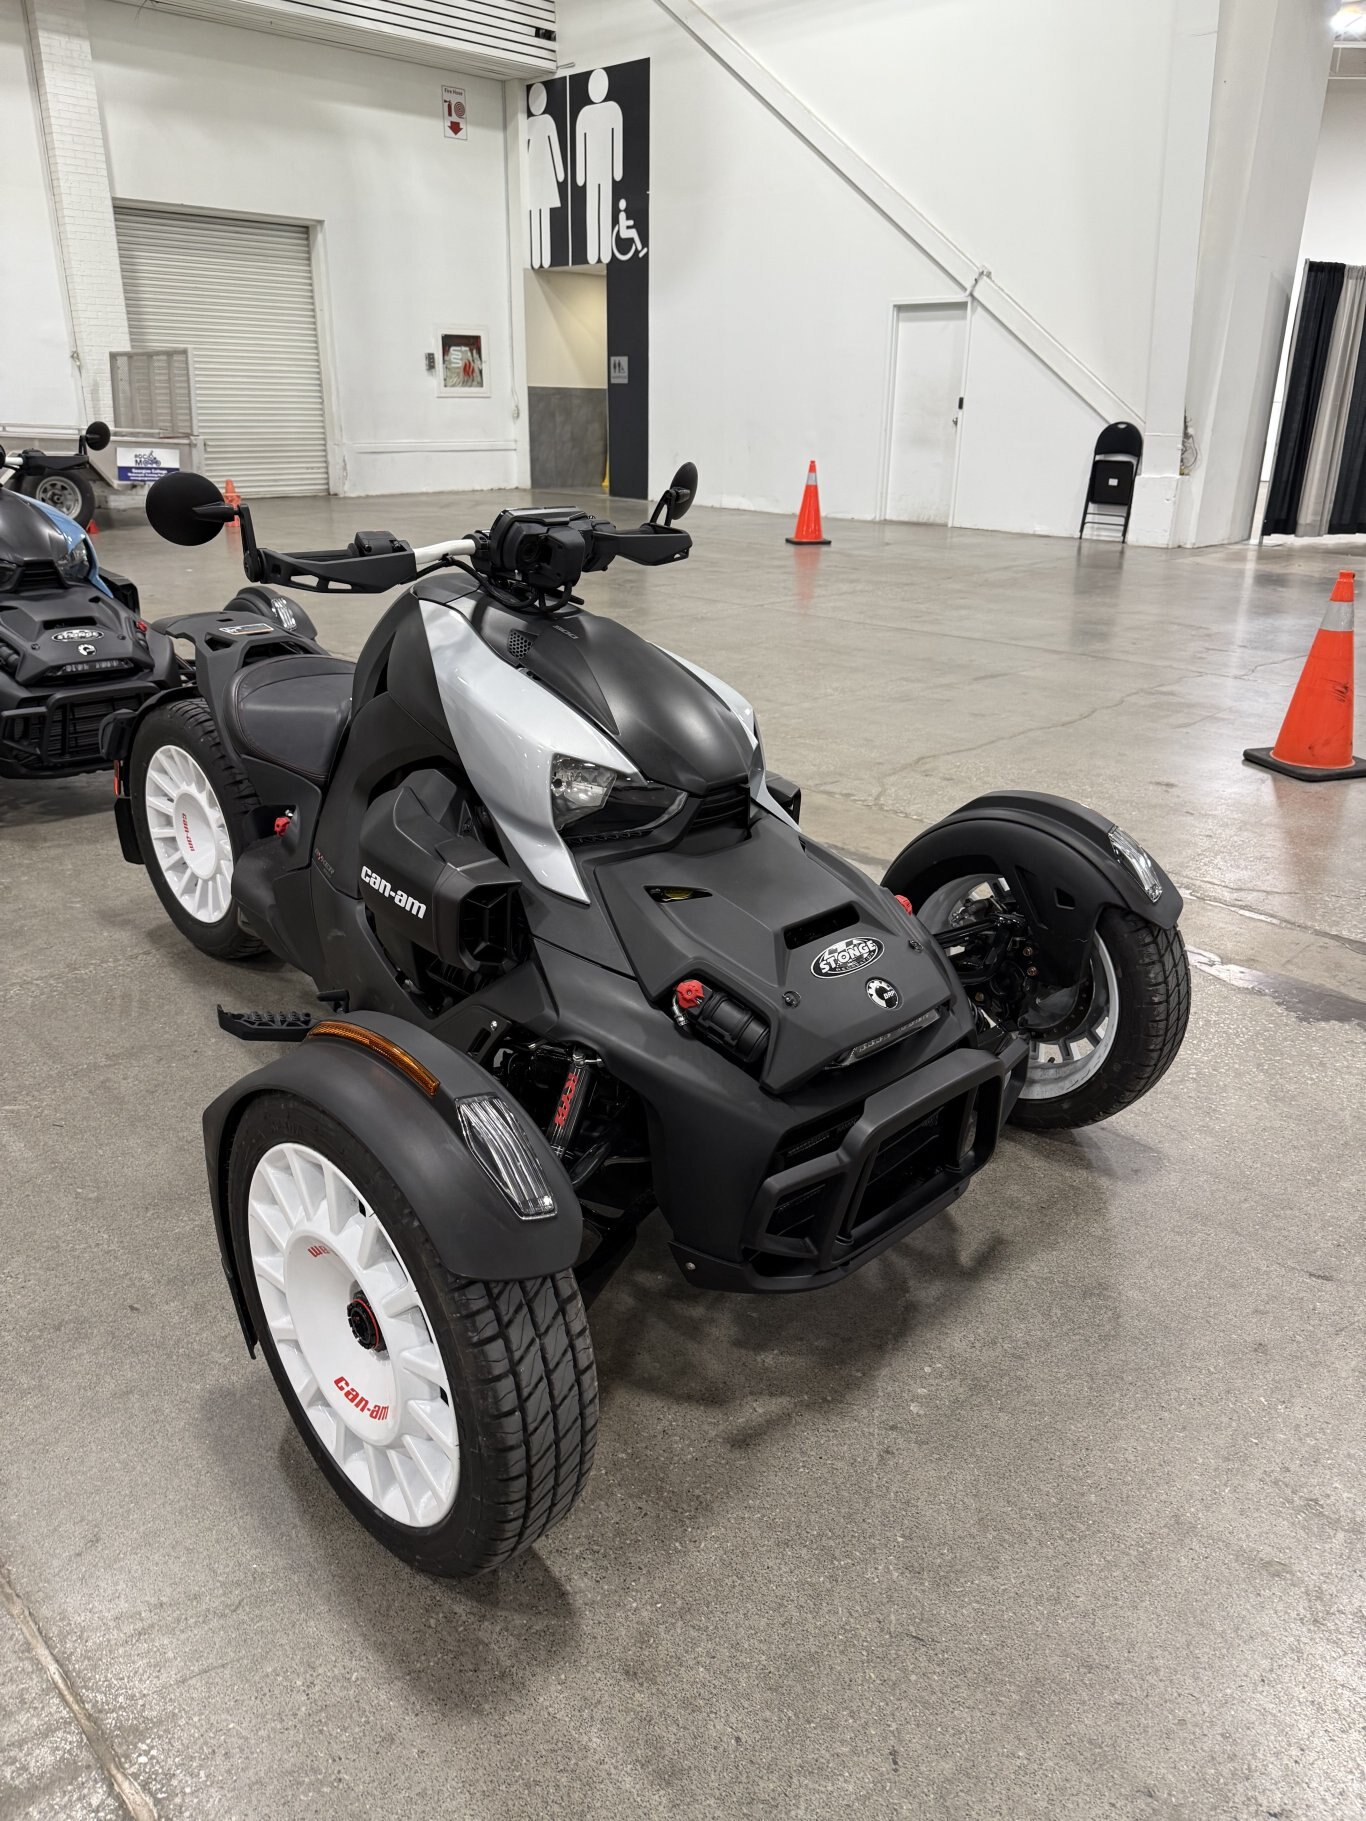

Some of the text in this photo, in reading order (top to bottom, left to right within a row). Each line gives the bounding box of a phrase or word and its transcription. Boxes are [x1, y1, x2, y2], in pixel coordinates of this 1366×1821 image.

[361, 865, 426, 919] can-am
[884, 990, 895, 1000] BRP
[334, 1375, 390, 1421] can-am
